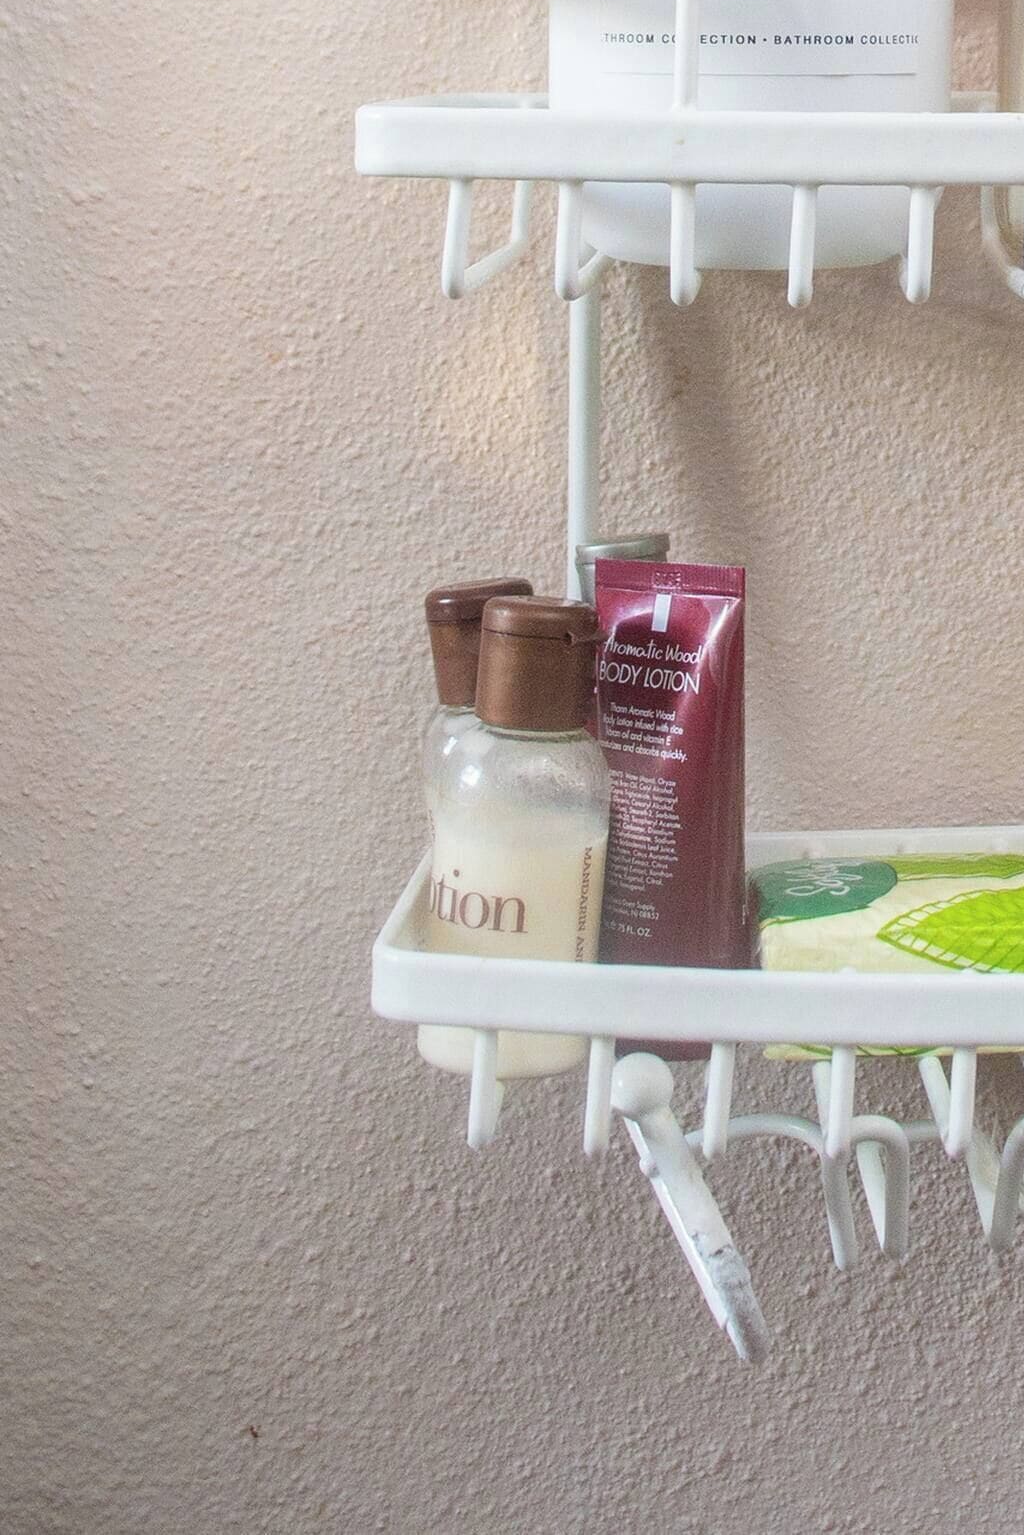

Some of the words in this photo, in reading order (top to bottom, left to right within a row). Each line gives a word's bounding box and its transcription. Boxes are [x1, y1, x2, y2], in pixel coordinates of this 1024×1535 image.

[774, 34, 854, 45] BATHROOM
[604, 636, 663, 659] Aromatic
[665, 644, 703, 664] Wood
[600, 660, 642, 685] BODY
[643, 667, 700, 695] LOTION
[666, 736, 672, 746] E
[577, 846, 593, 932] MANDARIN
